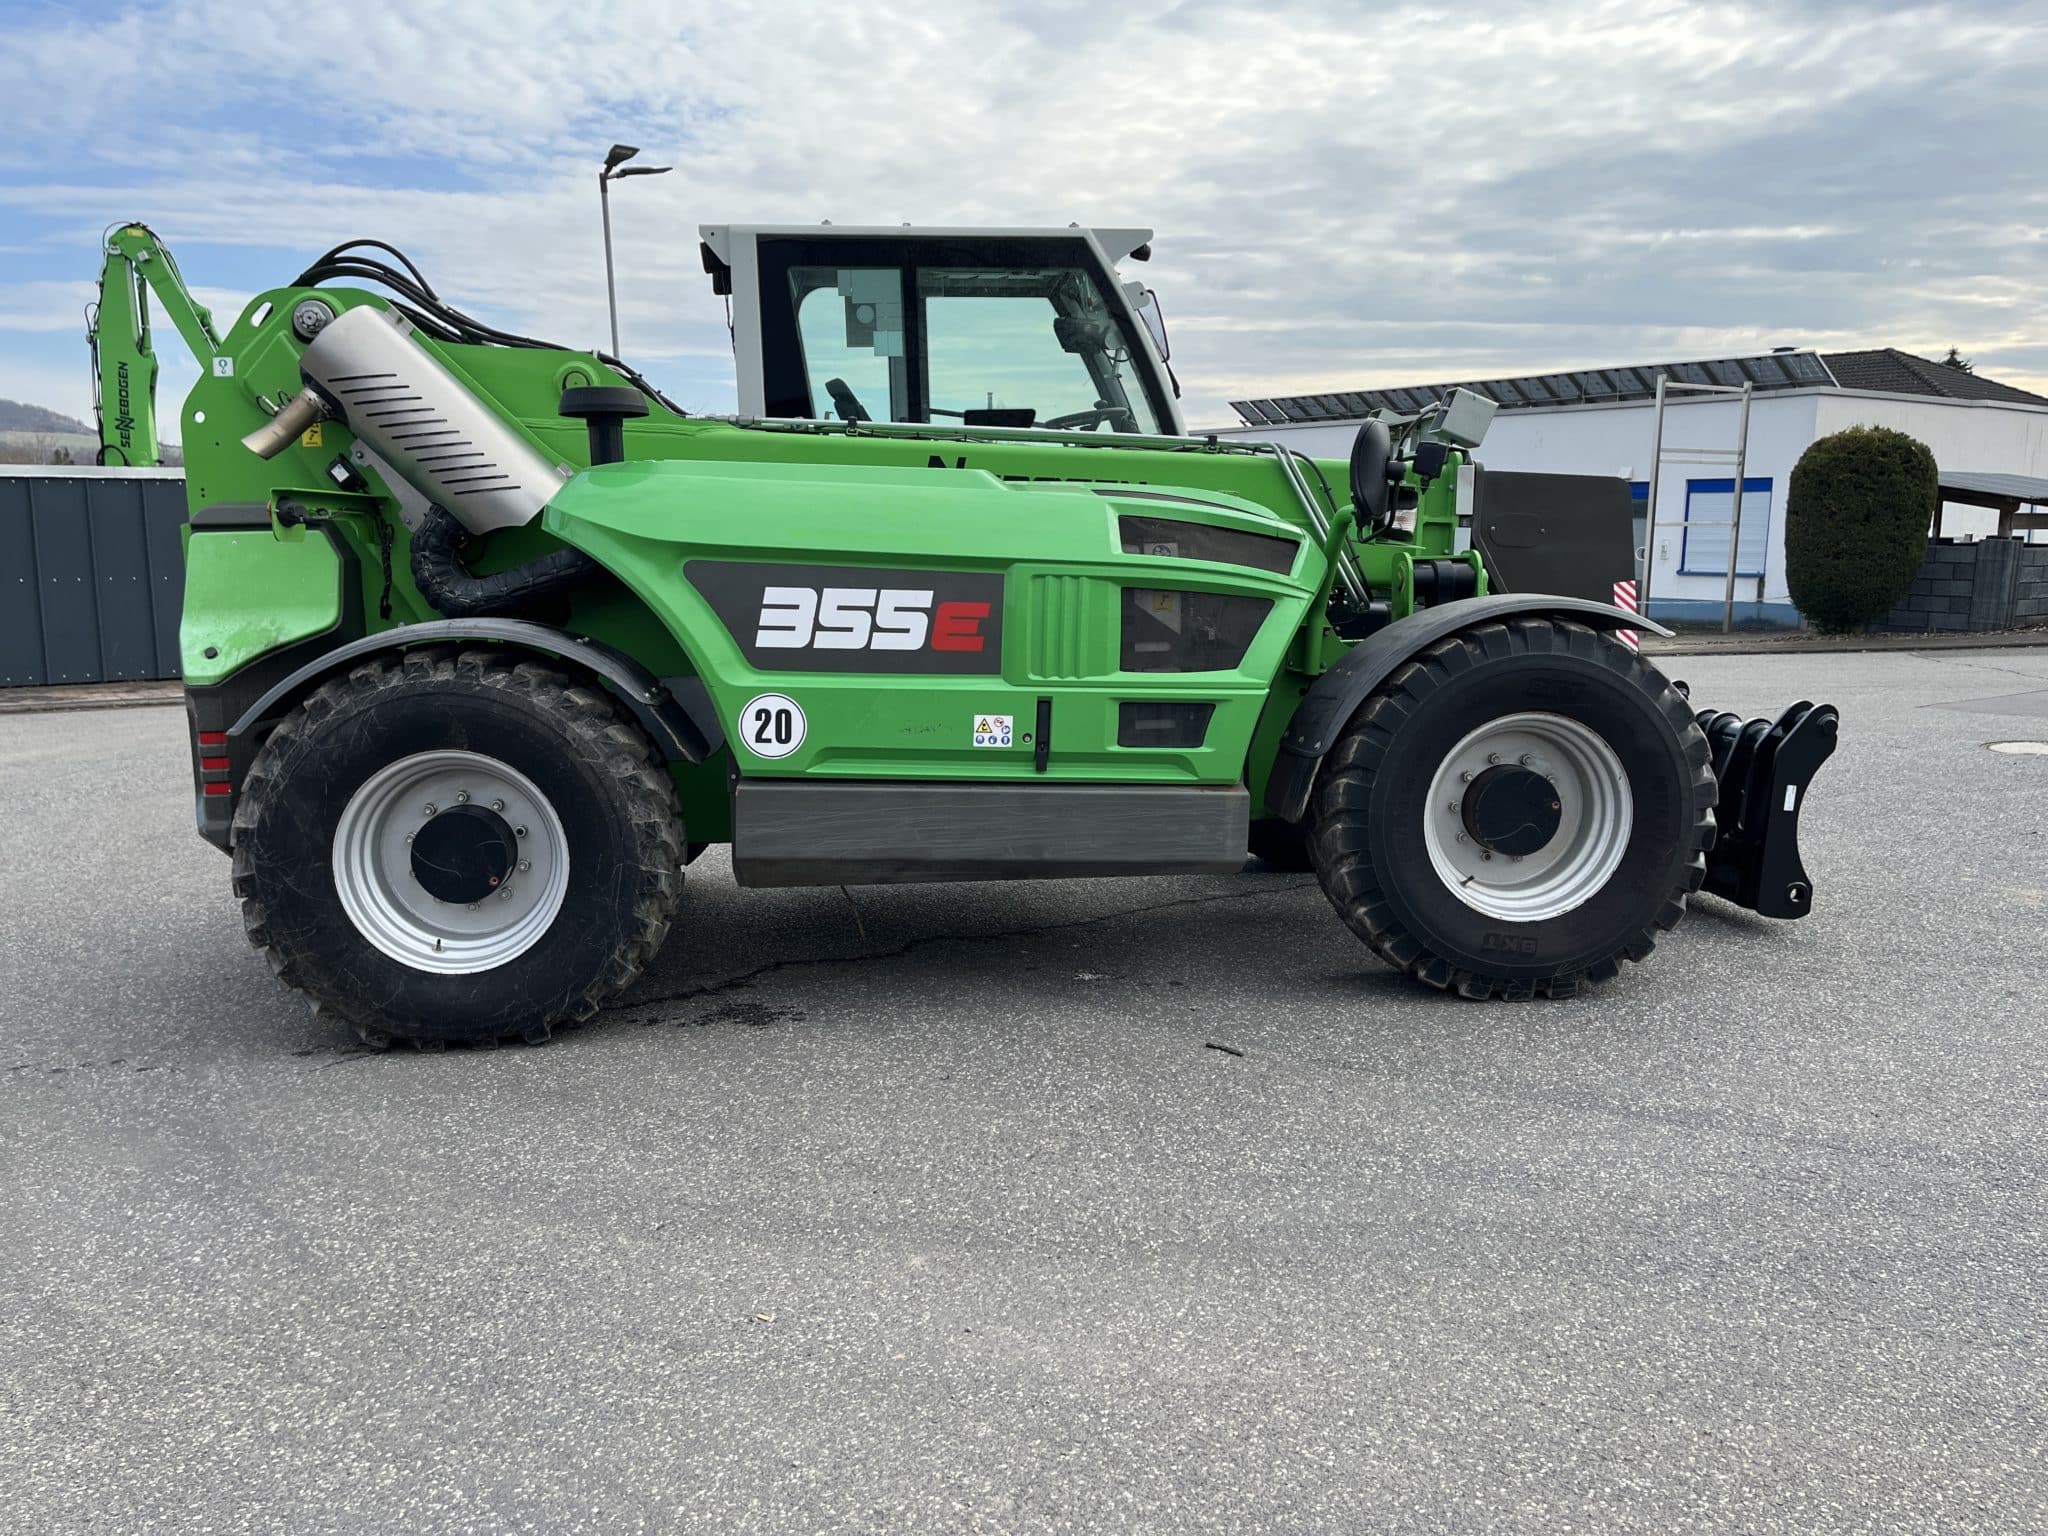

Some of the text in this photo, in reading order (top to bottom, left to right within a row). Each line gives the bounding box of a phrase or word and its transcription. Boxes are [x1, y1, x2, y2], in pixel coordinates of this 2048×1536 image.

[115, 361, 134, 448] SENNEBOGEN
[755, 586, 991, 651] 355E
[755, 708, 792, 745] 20
